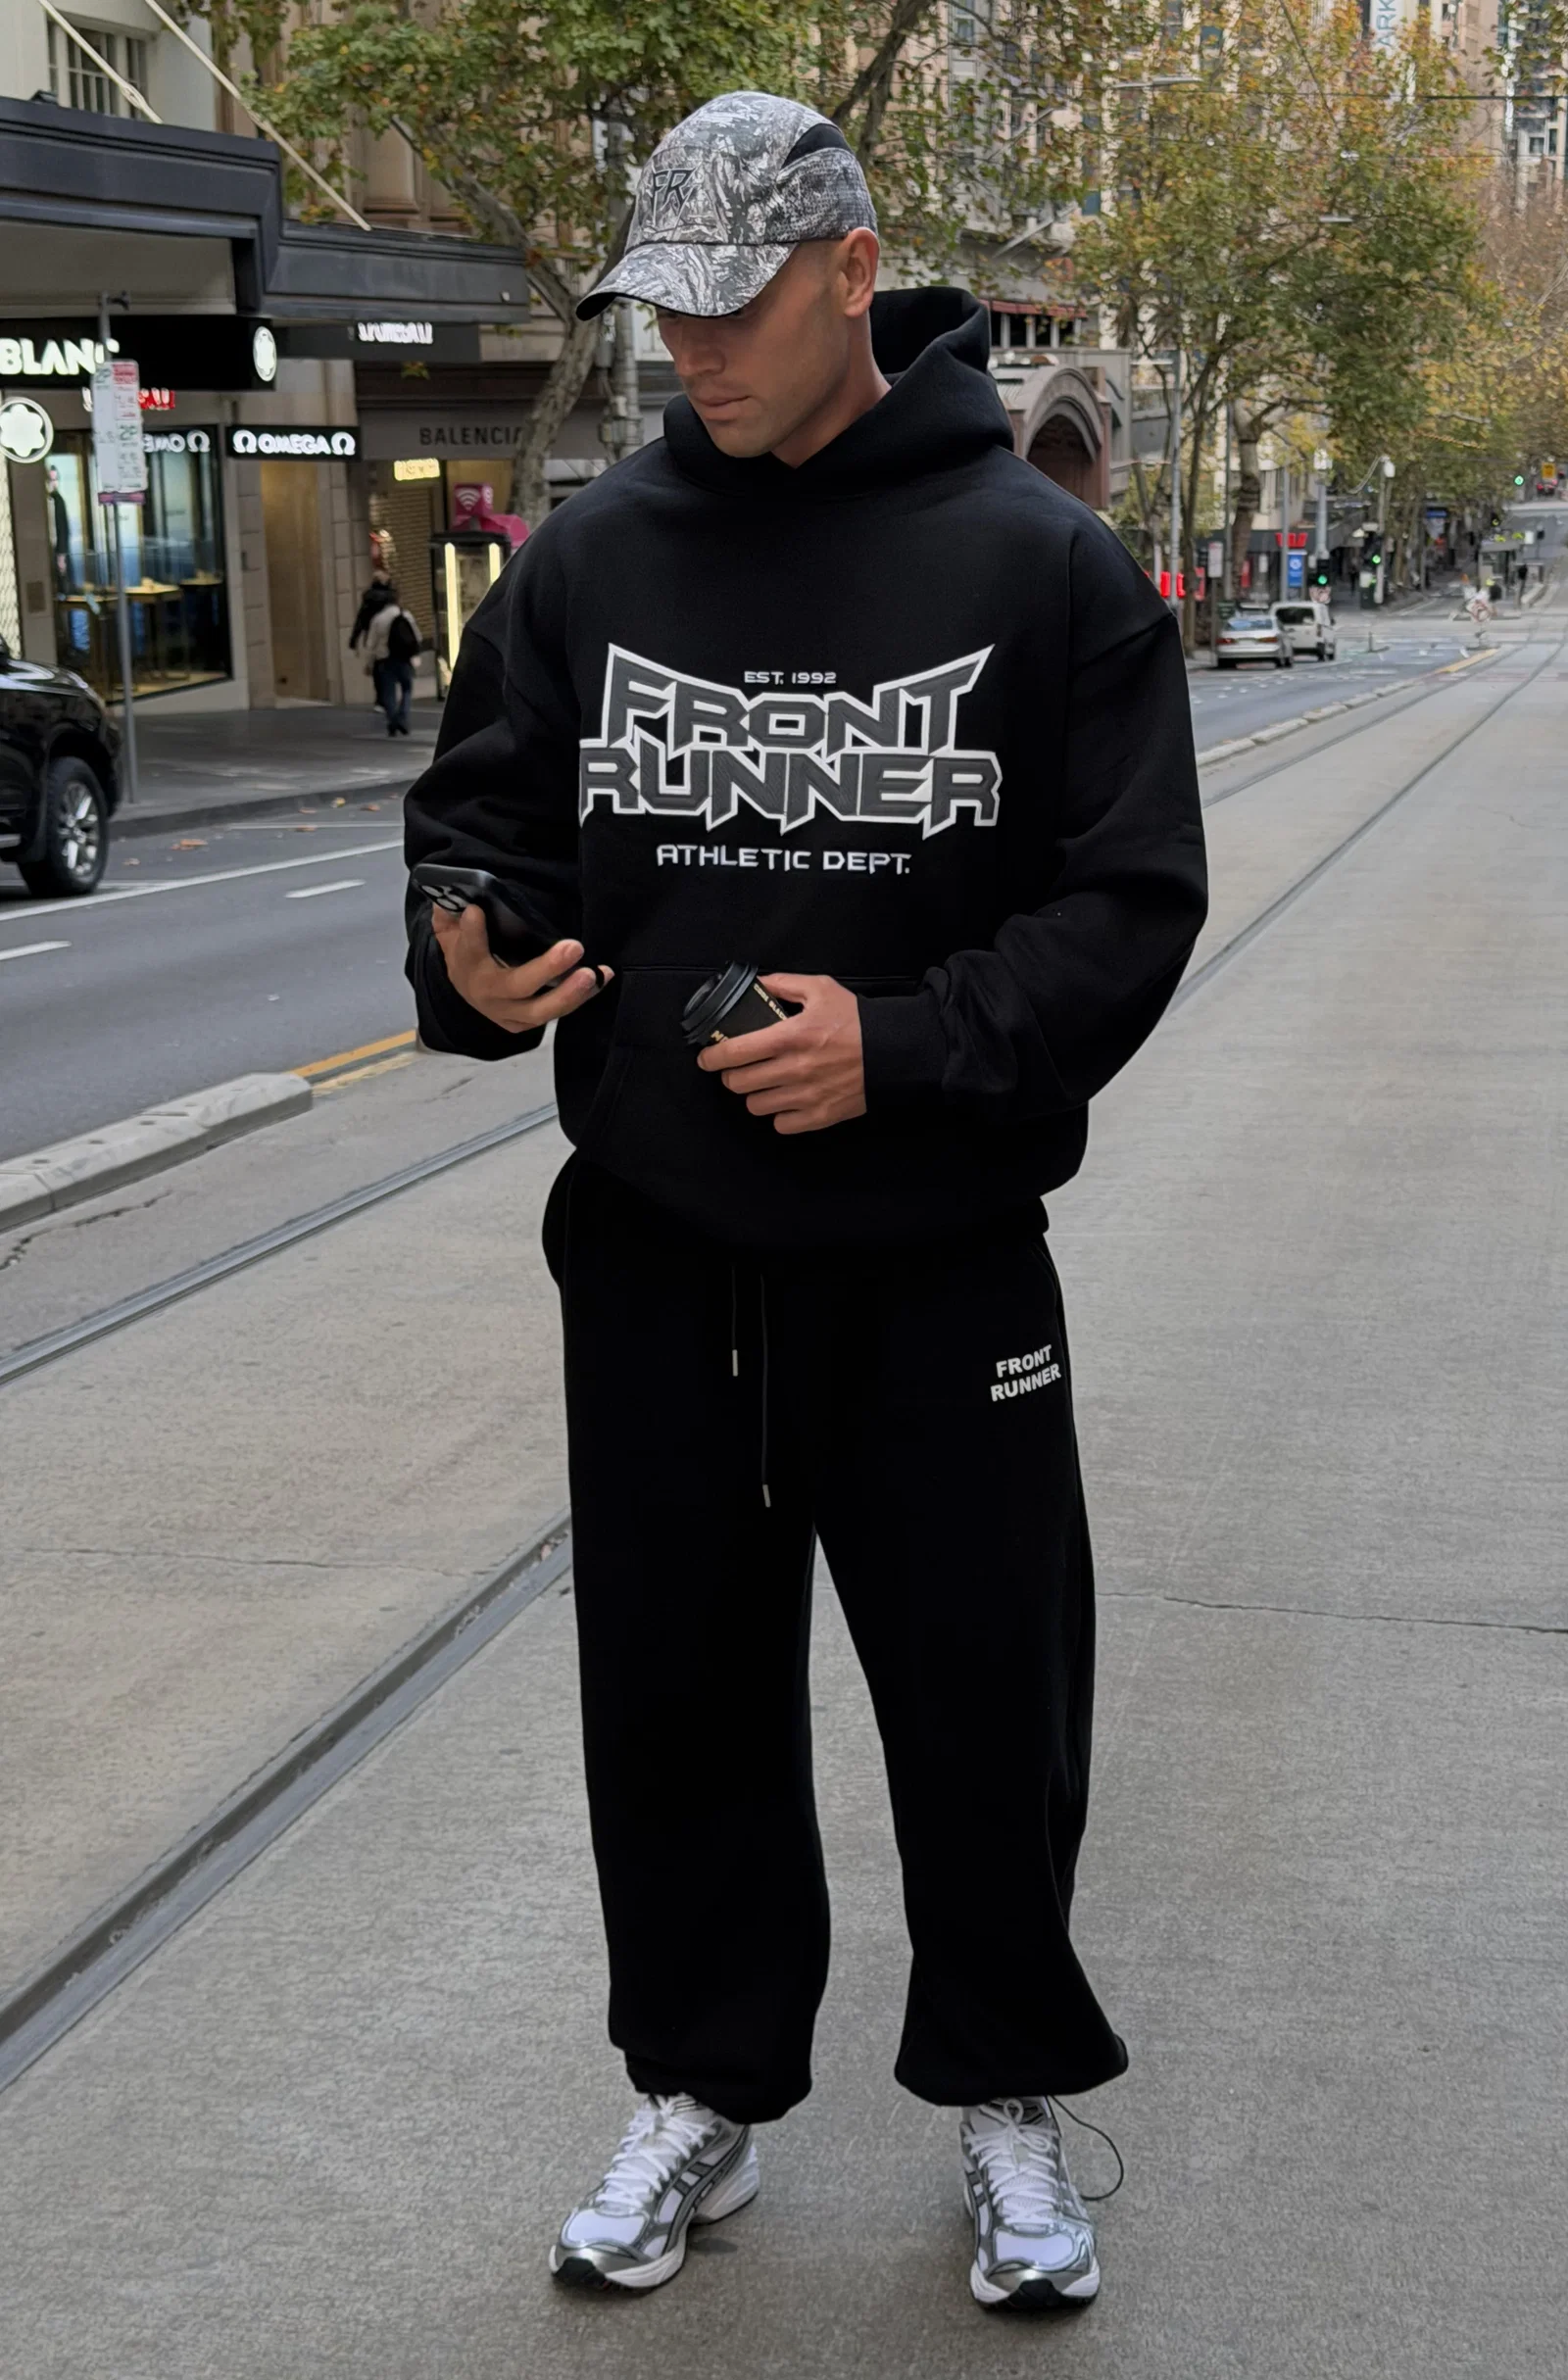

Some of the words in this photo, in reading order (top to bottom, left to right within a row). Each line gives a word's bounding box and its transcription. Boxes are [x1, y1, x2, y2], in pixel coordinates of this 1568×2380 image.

[258, 433, 331, 455] OMEGA
[744, 670, 784, 685] EST.
[792, 671, 837, 684] 1992
[602, 643, 995, 761] FRONT
[579, 724, 1003, 840] RUNNER
[657, 844, 811, 871] ATHLETIC
[822, 850, 911, 874] DEPT.
[996, 1343, 1052, 1379] FRONT
[990, 1363, 1061, 1402] RUNNER
